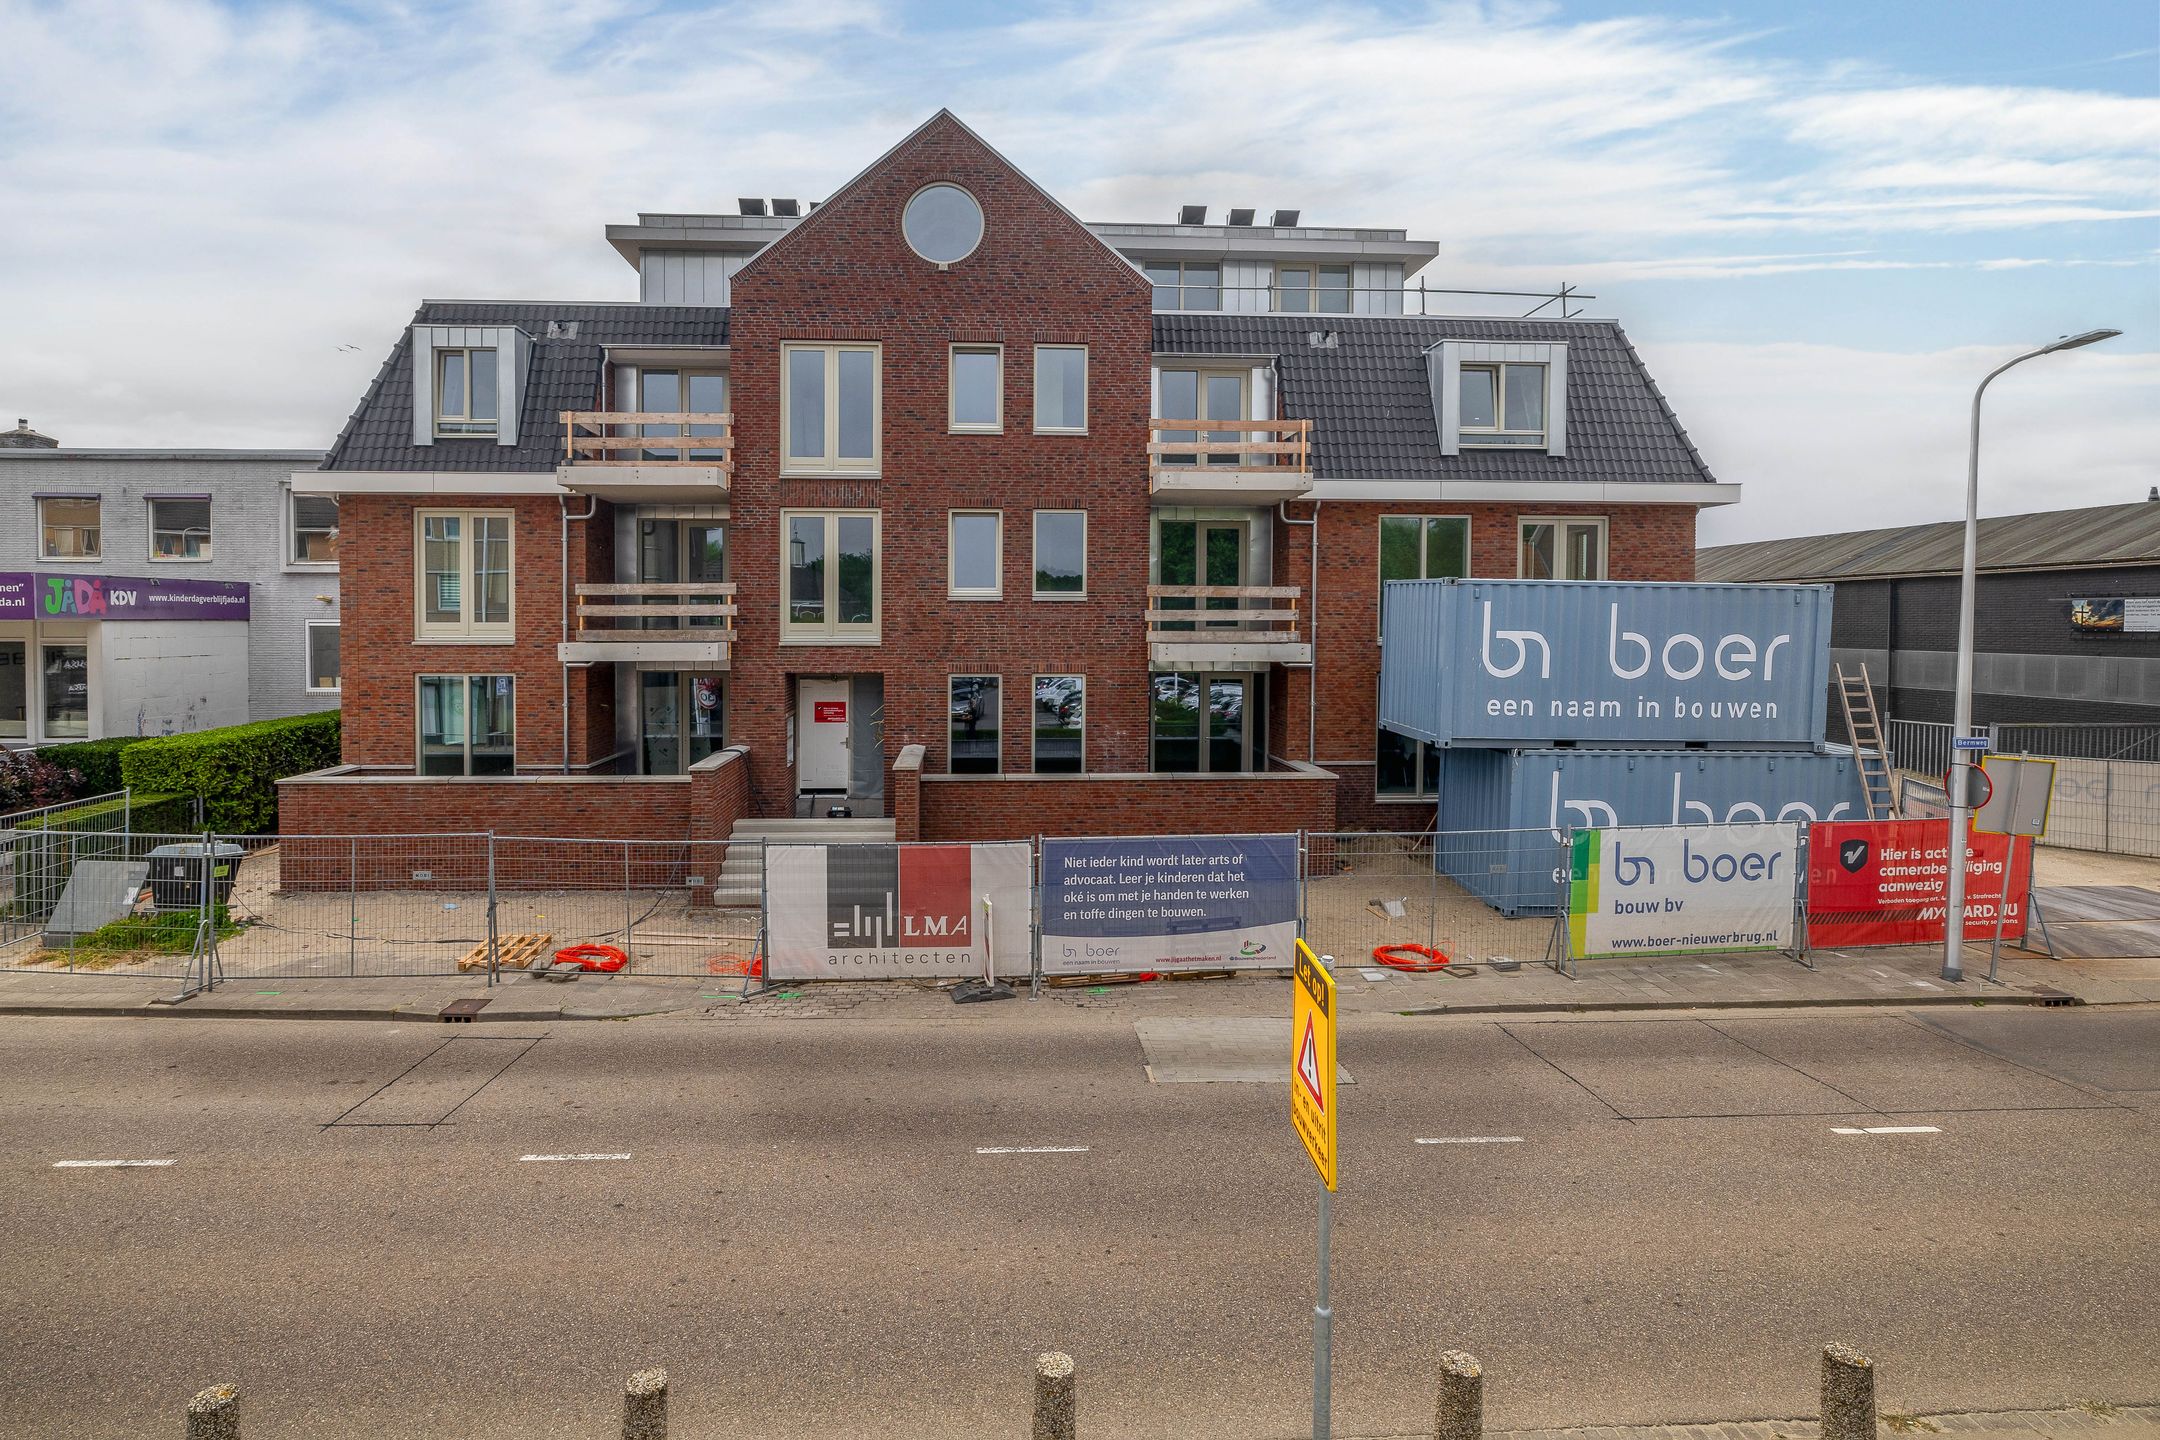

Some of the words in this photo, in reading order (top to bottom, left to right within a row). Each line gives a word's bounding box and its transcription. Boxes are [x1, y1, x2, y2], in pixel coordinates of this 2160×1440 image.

[110, 590, 137, 606] KDV
[148, 594, 245, 605] www.kinderdagverblijfjada.nl
[1609, 602, 1790, 681] boer
[1487, 699, 1534, 717] een
[1551, 699, 1621, 718] naam
[1637, 696, 1660, 718] in
[1674, 696, 1778, 719] bouwen
[1957, 739, 1987, 747] Bermweg
[1064, 857, 1087, 868] Niet
[1090, 856, 1117, 867] ieder
[1120, 855, 1143, 866] kind
[1146, 854, 1178, 866] wordt
[1181, 854, 1206, 865] later
[1209, 855, 1230, 865] arts
[1232, 854, 1243, 864] of
[1683, 838, 1782, 884] boer
[1880, 848, 1908, 861] Hier
[1910, 847, 1921, 860] is
[1924, 847, 1974, 859] acte
[1879, 860, 2003, 877] camerabeliging
[1063, 874, 1116, 885] advocaat.
[1119, 873, 1142, 884] Leer
[1144, 872, 1155, 885] je
[1157, 871, 1205, 883] kinderen
[1207, 871, 1224, 882] dat
[1227, 870, 1245, 881] het
[1878, 878, 1944, 893] aanwezig
[1063, 891, 1083, 902] oké
[1086, 891, 1096, 902] is
[1098, 893, 1115, 902] om
[1118, 891, 1138, 901] met
[1141, 890, 1151, 902] je
[1153, 889, 1193, 900] handen
[1196, 889, 1207, 899] te
[1209, 888, 1249, 899] werken
[1878, 897, 1904, 905] Verboden
[1905, 896, 1929, 904] toegang
[1972, 892, 2002, 900] Strafrecht
[1063, 911, 1077, 920] en
[1080, 908, 1106, 919] toffe
[1108, 907, 1144, 920] dingen
[1147, 908, 1159, 918] te
[1161, 906, 1207, 917] bouwen.
[1615, 899, 1660, 915] bouw
[1664, 897, 1684, 913] bv
[1917, 903, 2018, 920] MYARD.U
[904, 915, 967, 936] LMA
[1965, 919, 1990, 927] security
[1611, 929, 1778, 949] www.boer-nieuwerbrug.nl
[1085, 943, 1120, 957] boer
[828, 951, 971, 966] architecten
[1299, 952, 1311, 988] Let
[1312, 977, 1325, 1007] op!
[1302, 1095, 1310, 1115] en
[1311, 1109, 1326, 1144] uitrit
[1293, 1099, 1328, 1170] bouwverkeer
